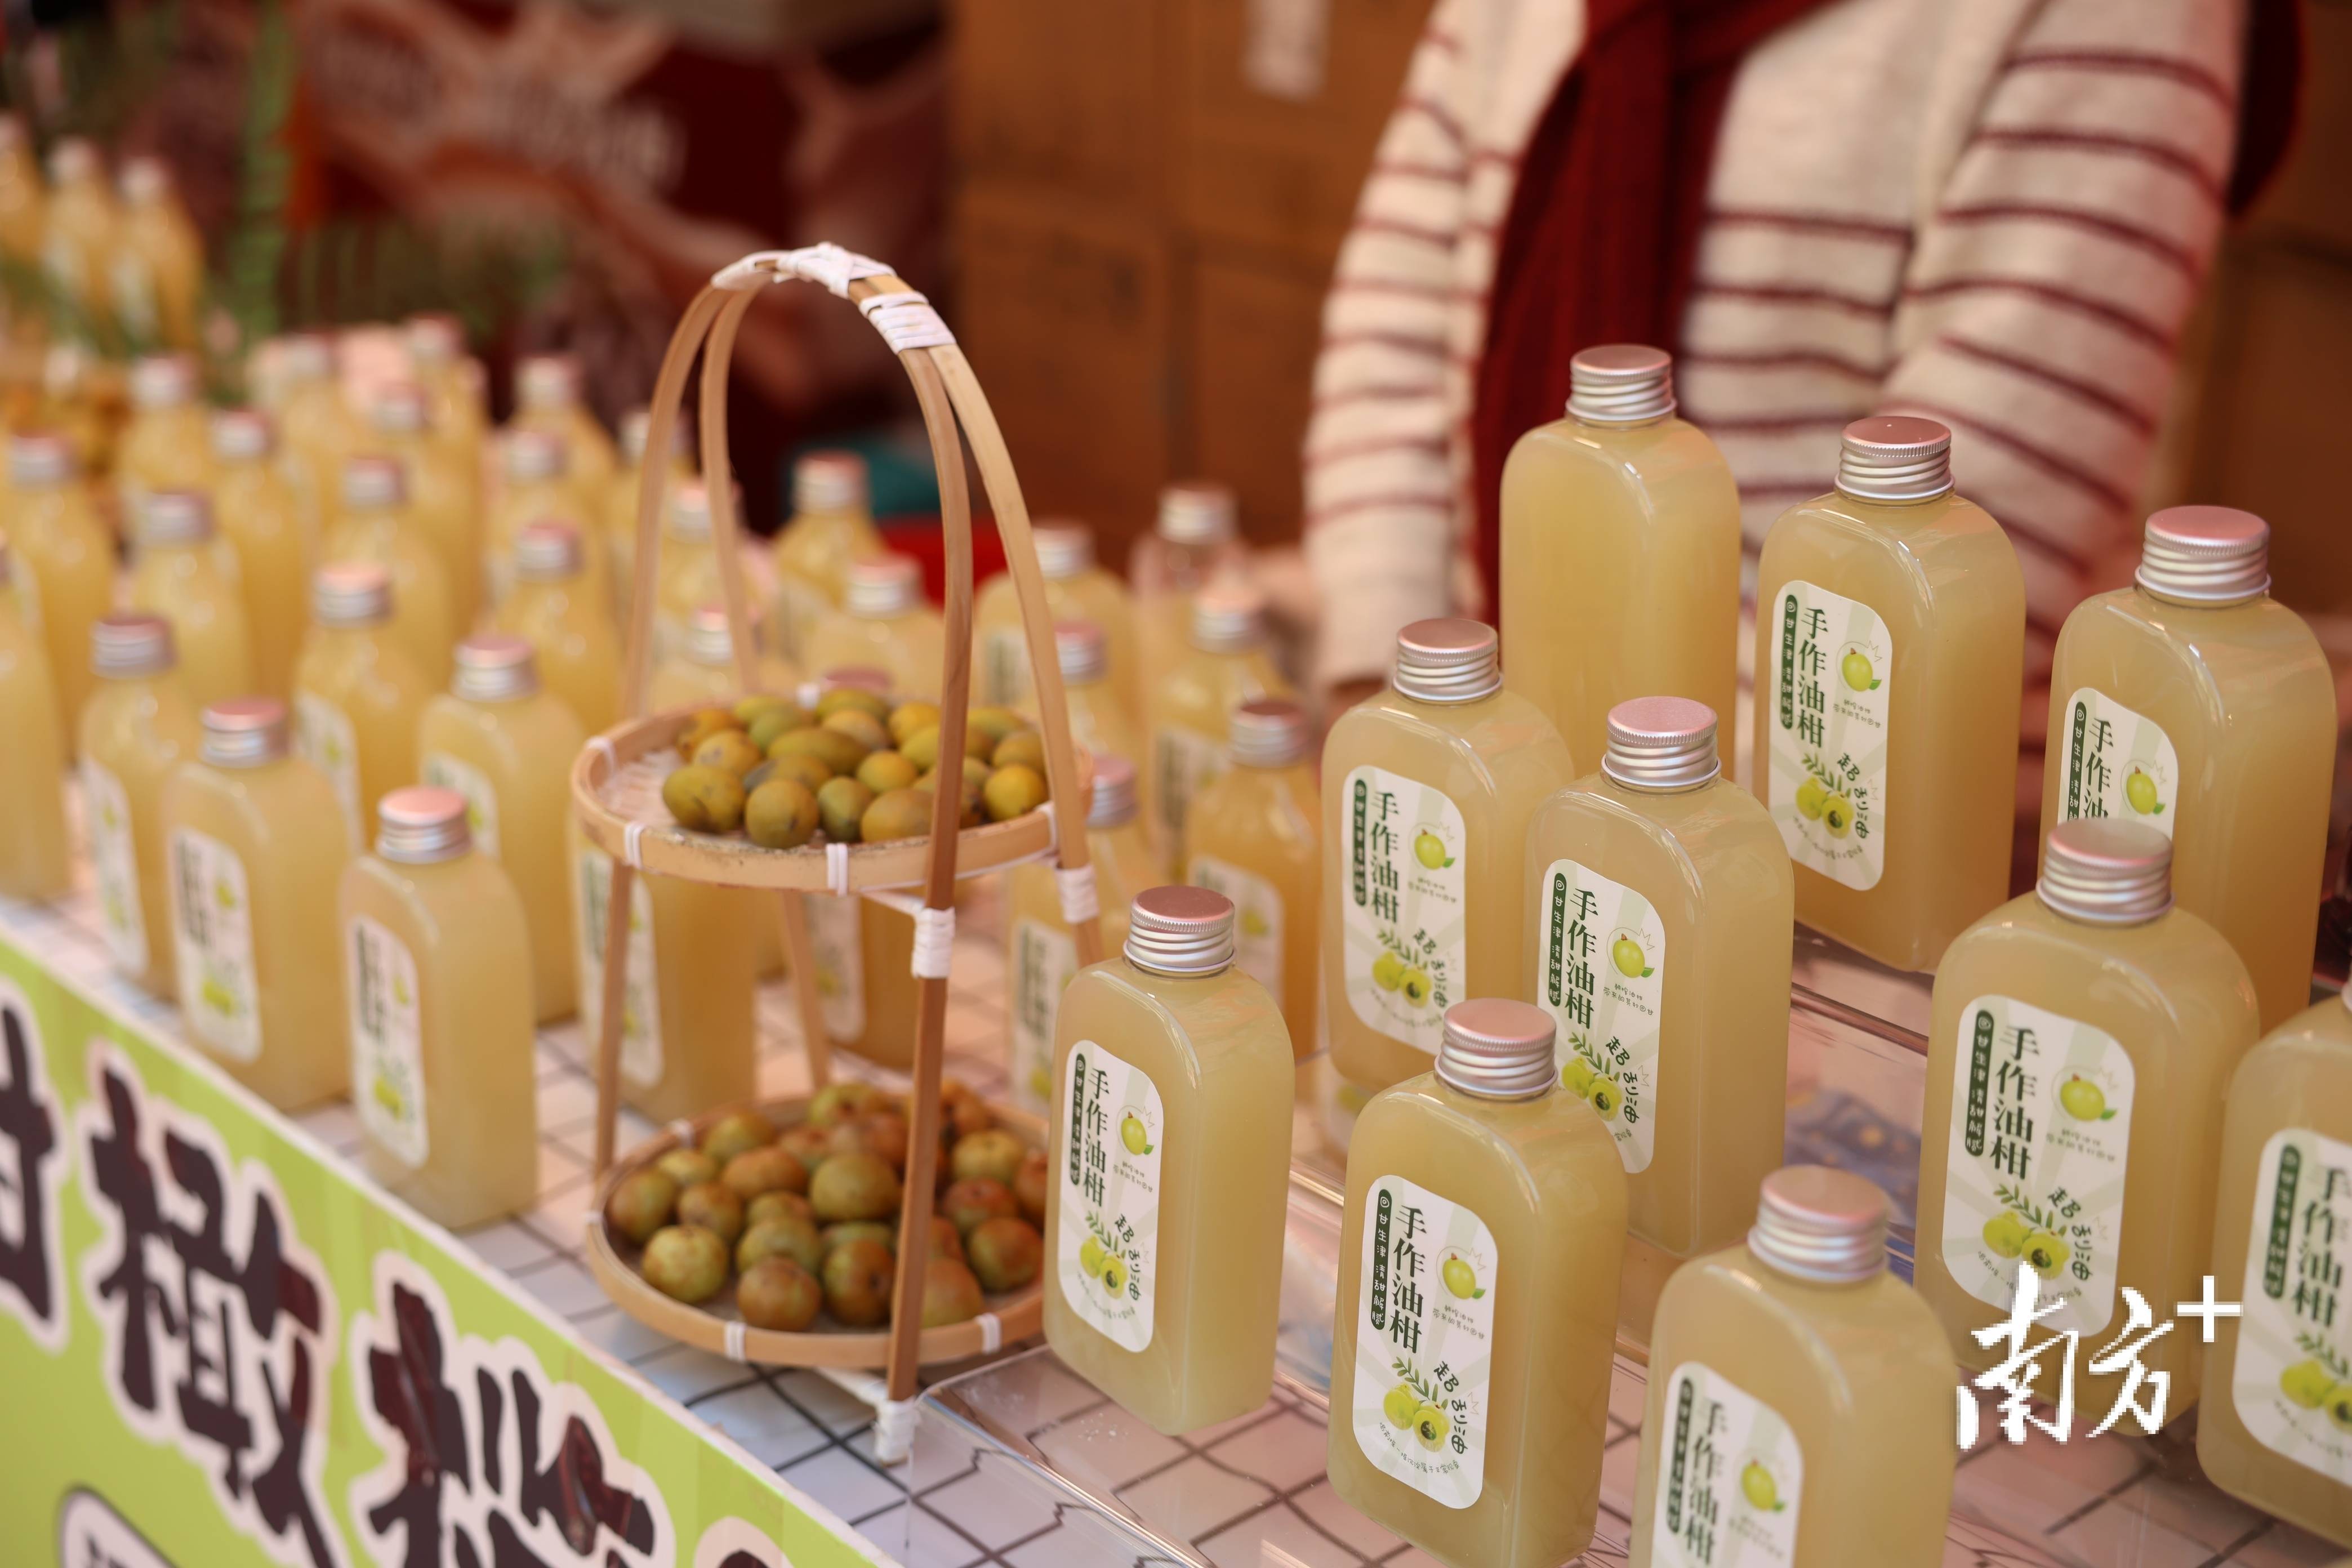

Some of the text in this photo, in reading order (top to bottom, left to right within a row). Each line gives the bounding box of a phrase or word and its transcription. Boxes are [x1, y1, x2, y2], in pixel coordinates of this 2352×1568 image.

[1797, 607, 1828, 748] 手作油柑
[1370, 791, 1399, 924] 手作油柑
[1565, 888, 1598, 1030] 手作油柑
[1083, 1068, 1110, 1207] 手作油柑
[1989, 1025, 2040, 1181] 手作油柑
[1389, 1205, 1427, 1353] 手作油柑
